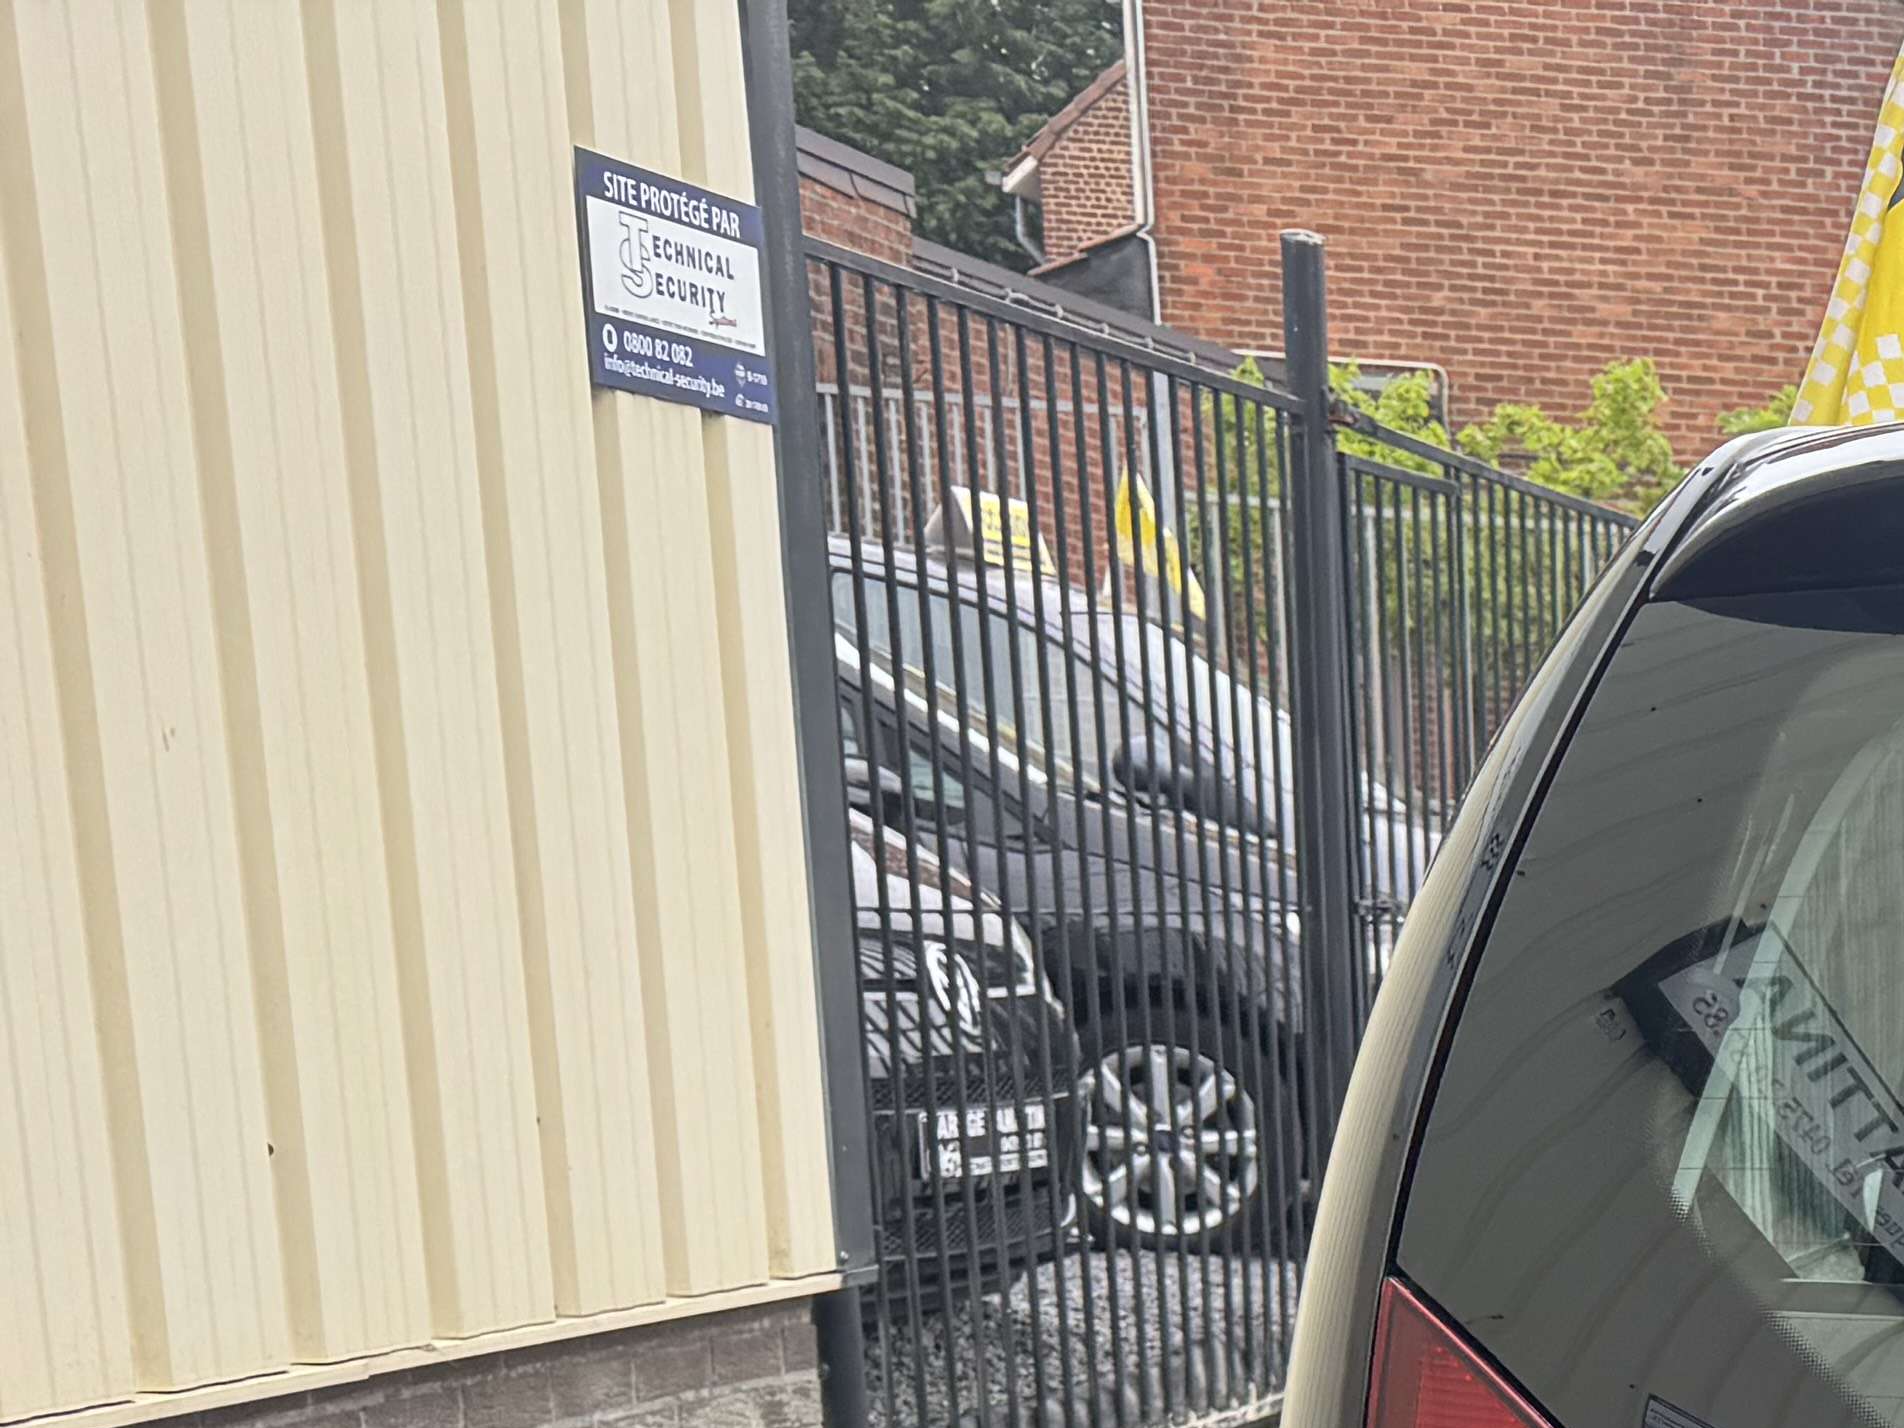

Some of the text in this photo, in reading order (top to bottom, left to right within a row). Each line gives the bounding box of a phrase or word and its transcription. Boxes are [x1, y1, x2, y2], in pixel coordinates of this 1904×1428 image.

[603, 171, 741, 239] SITE PROTÉGÉ PAR
[618, 210, 735, 280] TECHNICAL
[623, 330, 653, 357] 0800
[655, 338, 670, 362] 82
[603, 352, 726, 398] info@technical-security.be
